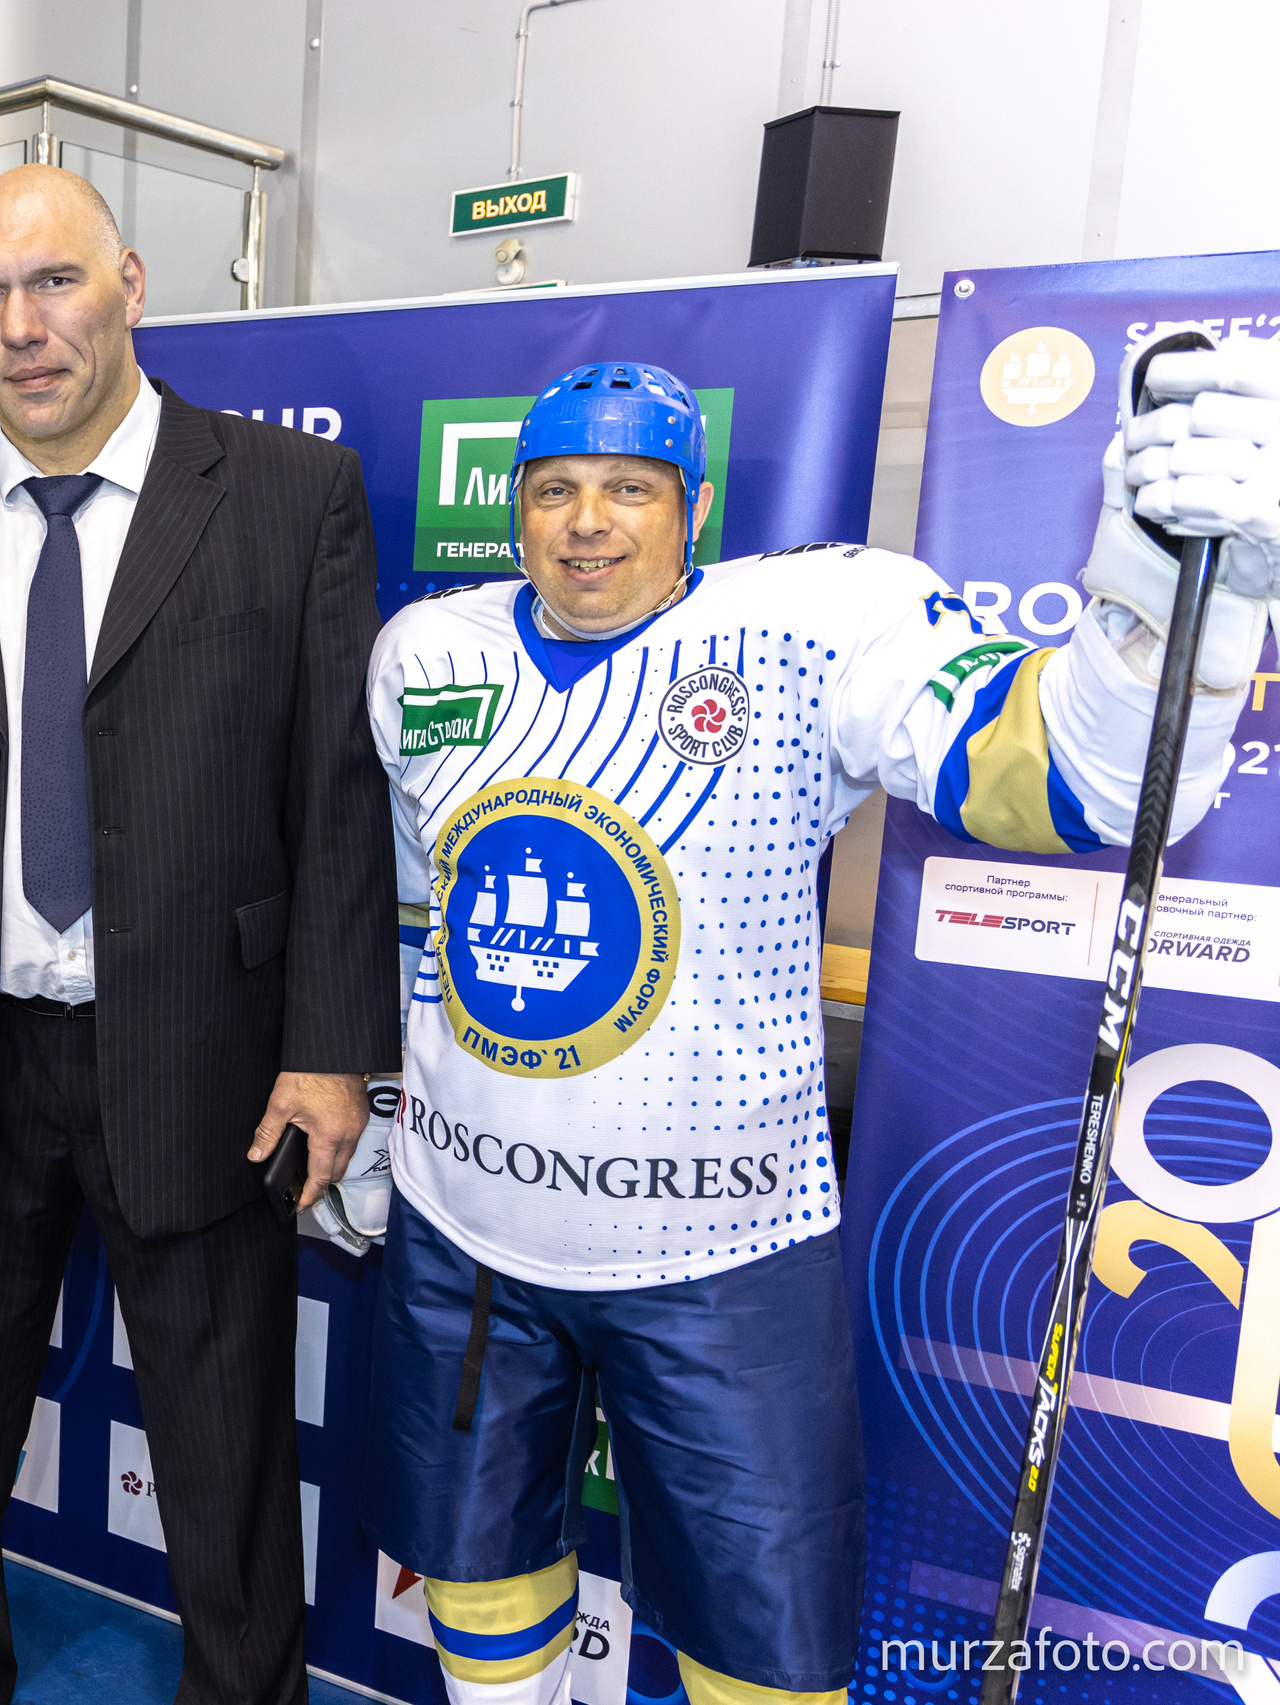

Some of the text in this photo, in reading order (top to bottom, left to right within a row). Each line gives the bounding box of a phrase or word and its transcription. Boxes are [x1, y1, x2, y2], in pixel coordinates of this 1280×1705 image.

[472, 190, 546, 220] ВЫХОД
[551, 397, 640, 420] JOFA
[666, 673, 747, 717] ROSCONGRESS
[399, 729, 427, 750] ИГА
[667, 723, 744, 758] SPORT CLUB
[441, 788, 583, 859] МЕЖДУНАРОДНЫЙ
[584, 805, 669, 964] ЭКОНОМИЧЕСКИЙ
[944, 883, 1068, 902] спортивной программы:
[986, 875, 1031, 888] Партнер
[1157, 892, 1228, 907] енеральный
[1207, 910, 1258, 922] партнер:
[935, 909, 1076, 936] TELESPORT
[1154, 930, 1251, 947] СПОРТИВНАЯ ОДЕЖДА
[1097, 897, 1146, 1050] CCM
[613, 968, 661, 1034] ФОРУМ
[409, 1095, 780, 1201] ROSCONGRESS
[1080, 1094, 1104, 1184] TERESHENKO
[1046, 1322, 1063, 1381] SUPER
[1028, 1376, 1059, 1468] TACKS
